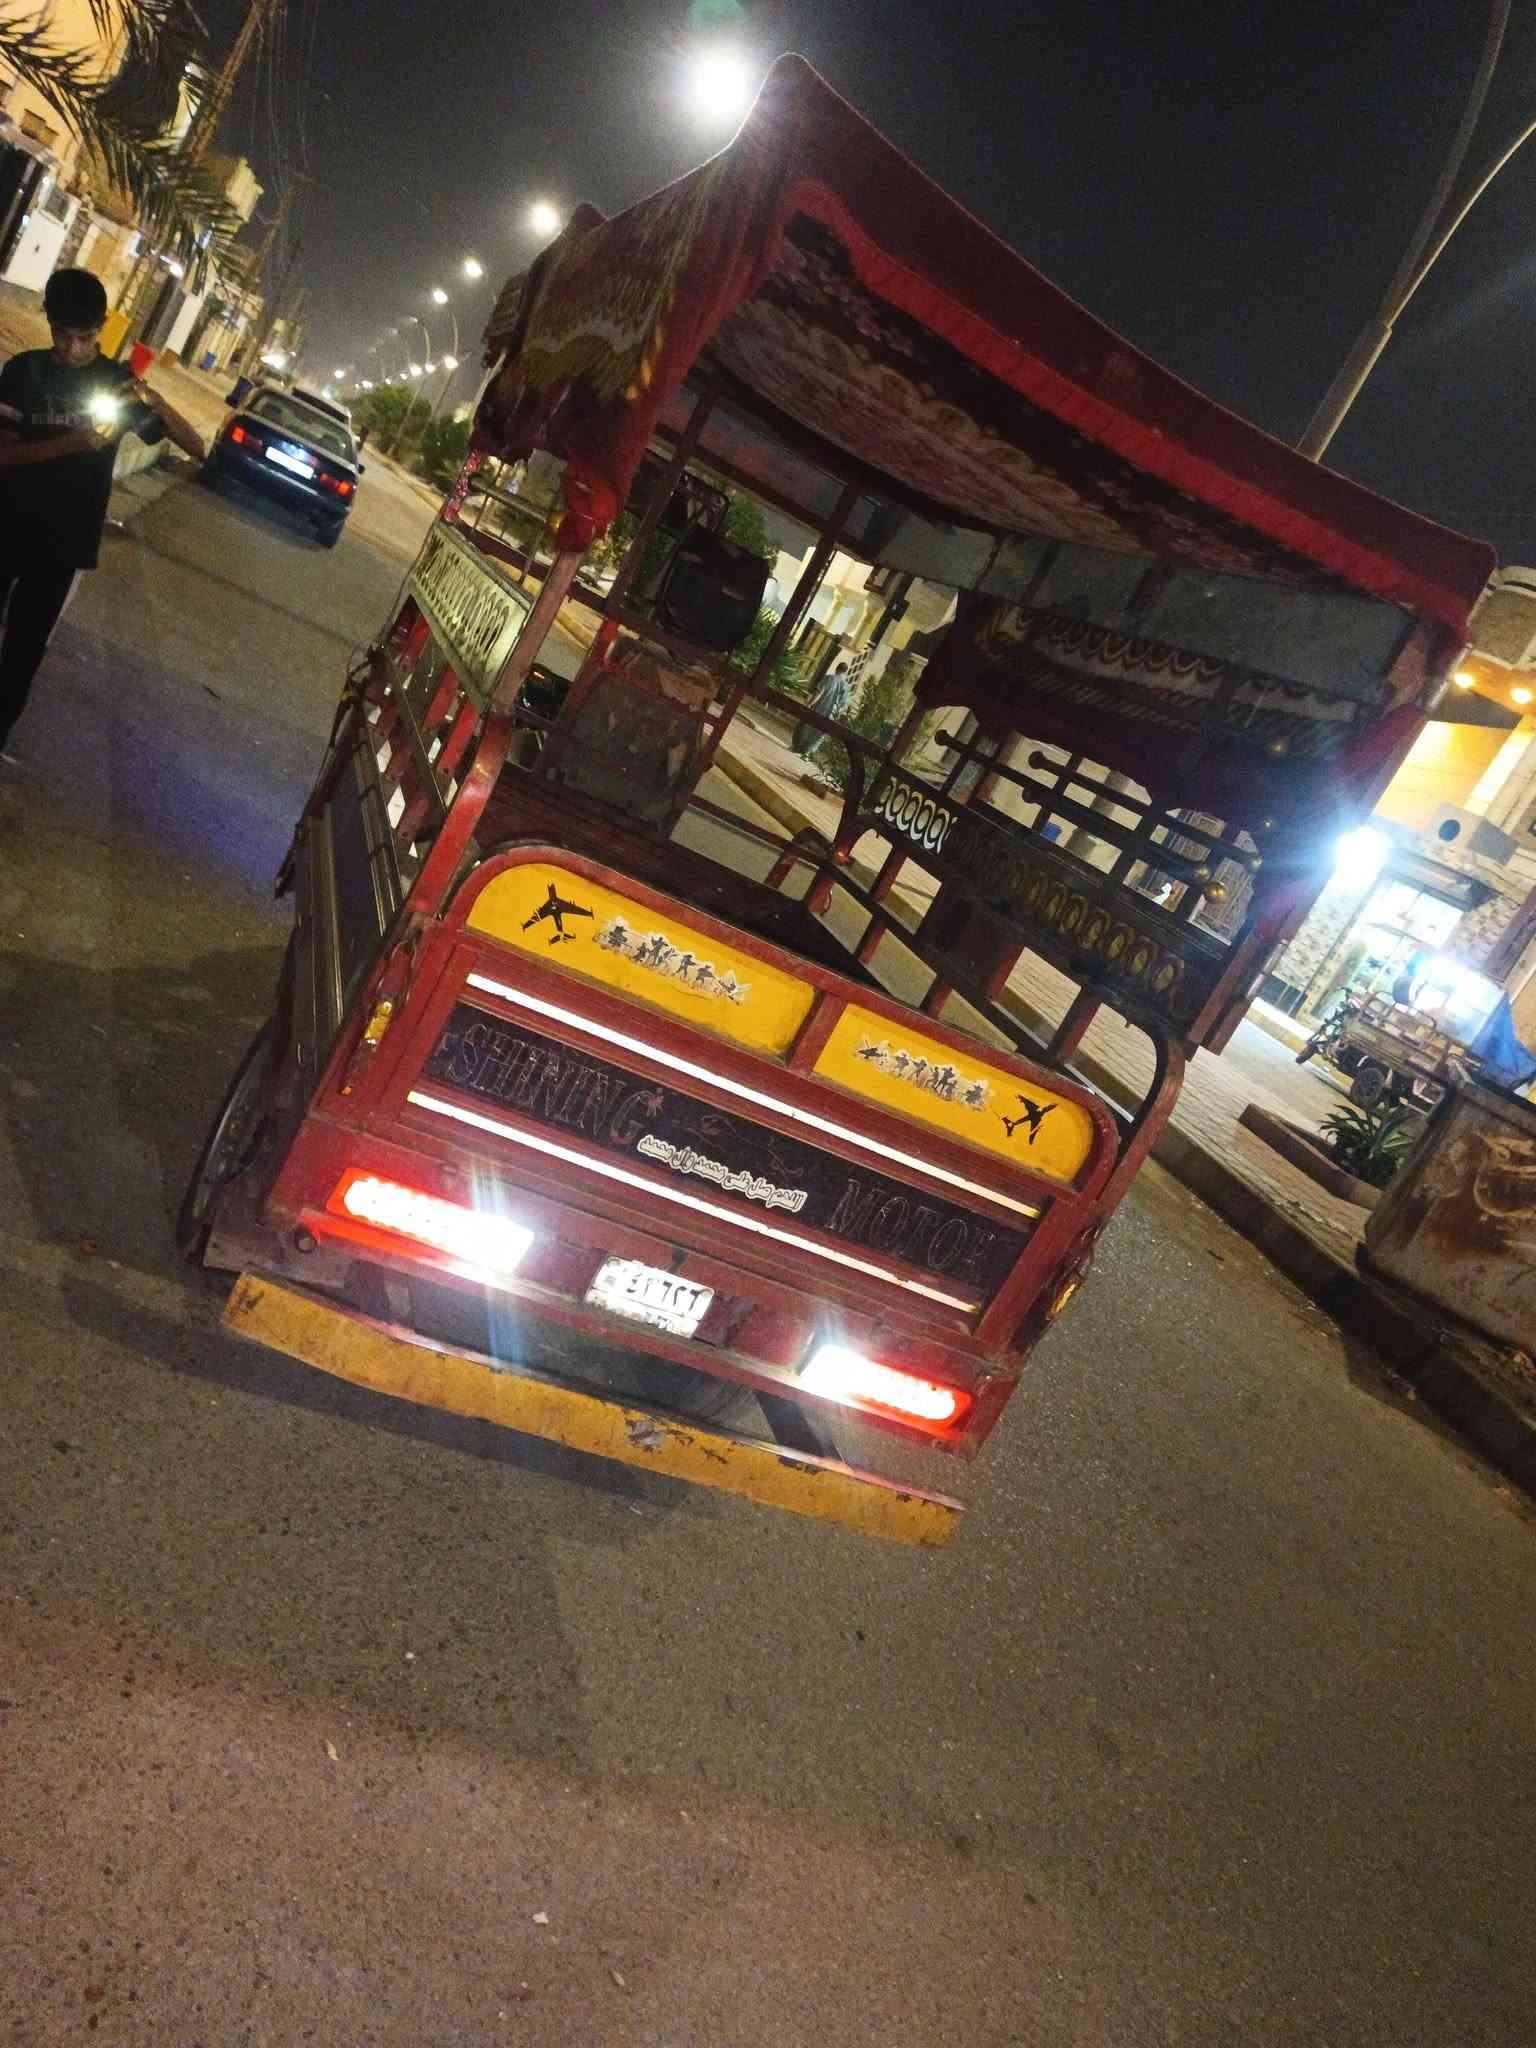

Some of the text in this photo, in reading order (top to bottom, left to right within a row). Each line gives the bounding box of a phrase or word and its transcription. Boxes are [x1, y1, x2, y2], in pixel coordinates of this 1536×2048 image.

[447, 1023, 660, 1145] SHINING
[637, 1135, 676, 1162] محمد
[694, 1156, 728, 1182] محمد
